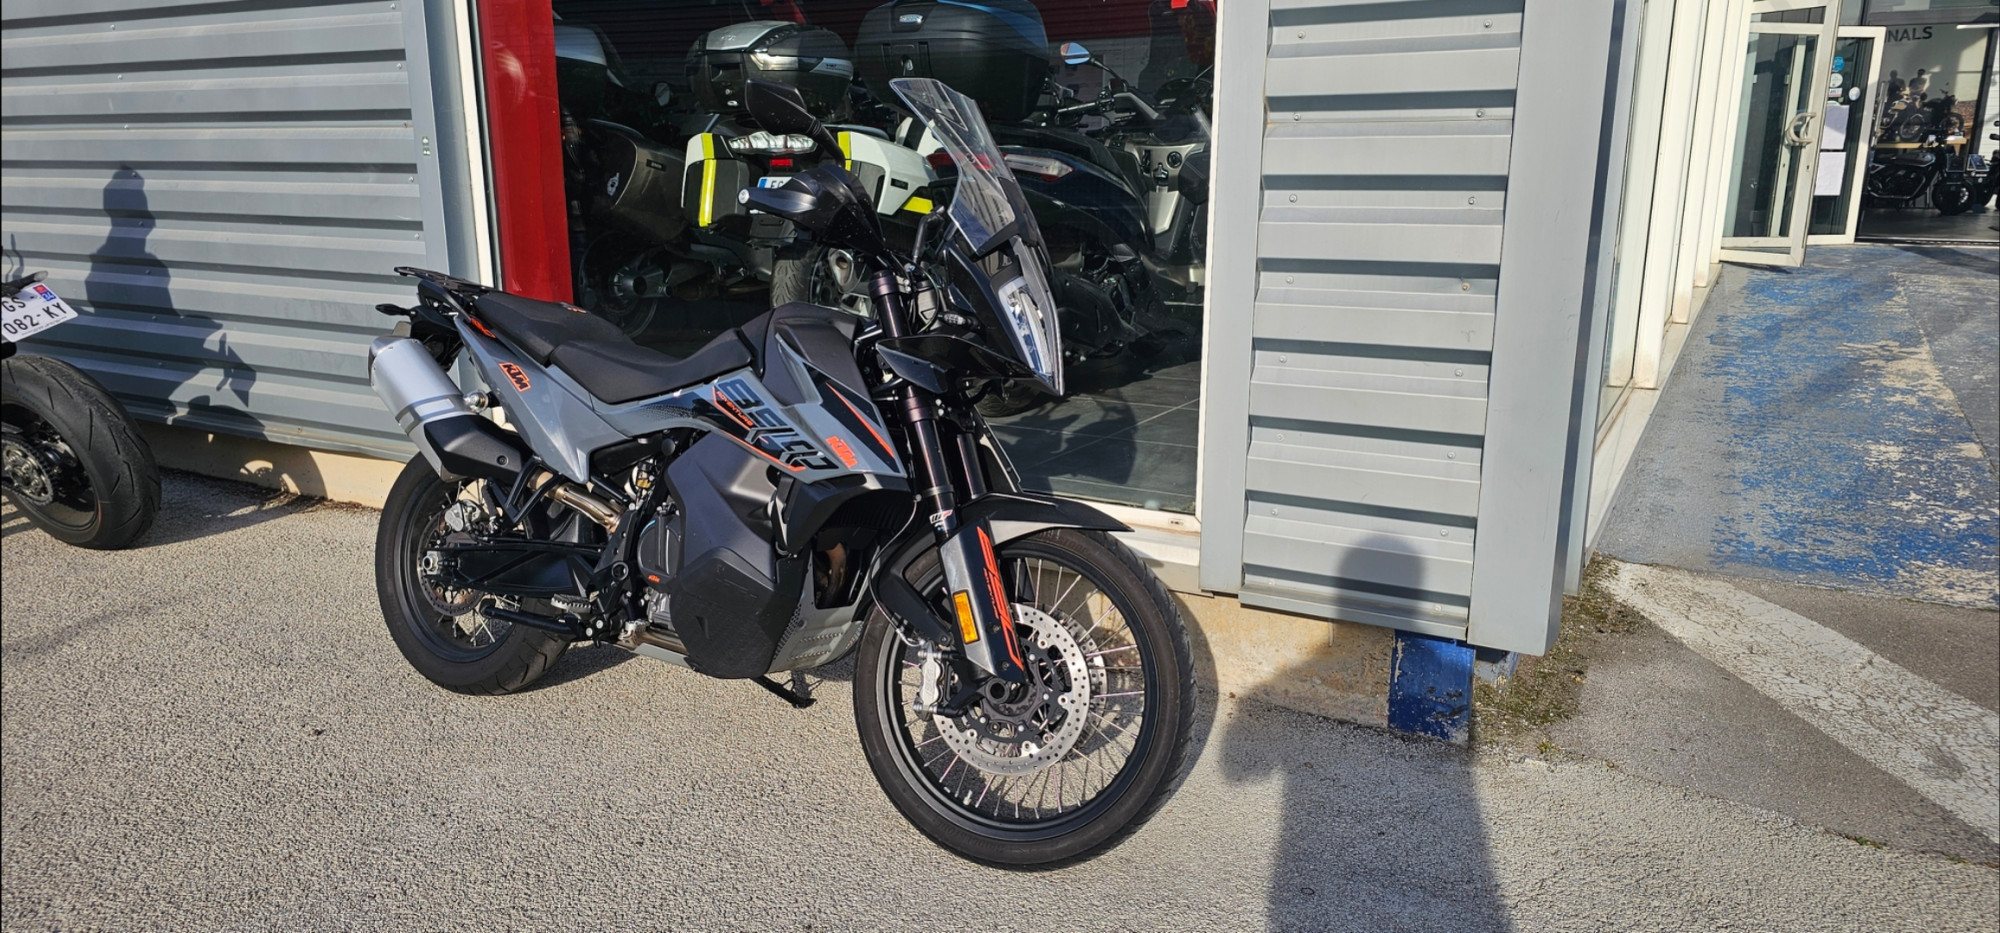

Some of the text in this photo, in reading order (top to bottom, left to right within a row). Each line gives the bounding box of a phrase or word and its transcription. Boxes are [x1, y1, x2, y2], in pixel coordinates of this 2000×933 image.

[501, 362, 531, 391] KTM
[717, 390, 754, 427] ADVENTURE
[825, 435, 858, 468] KTM
